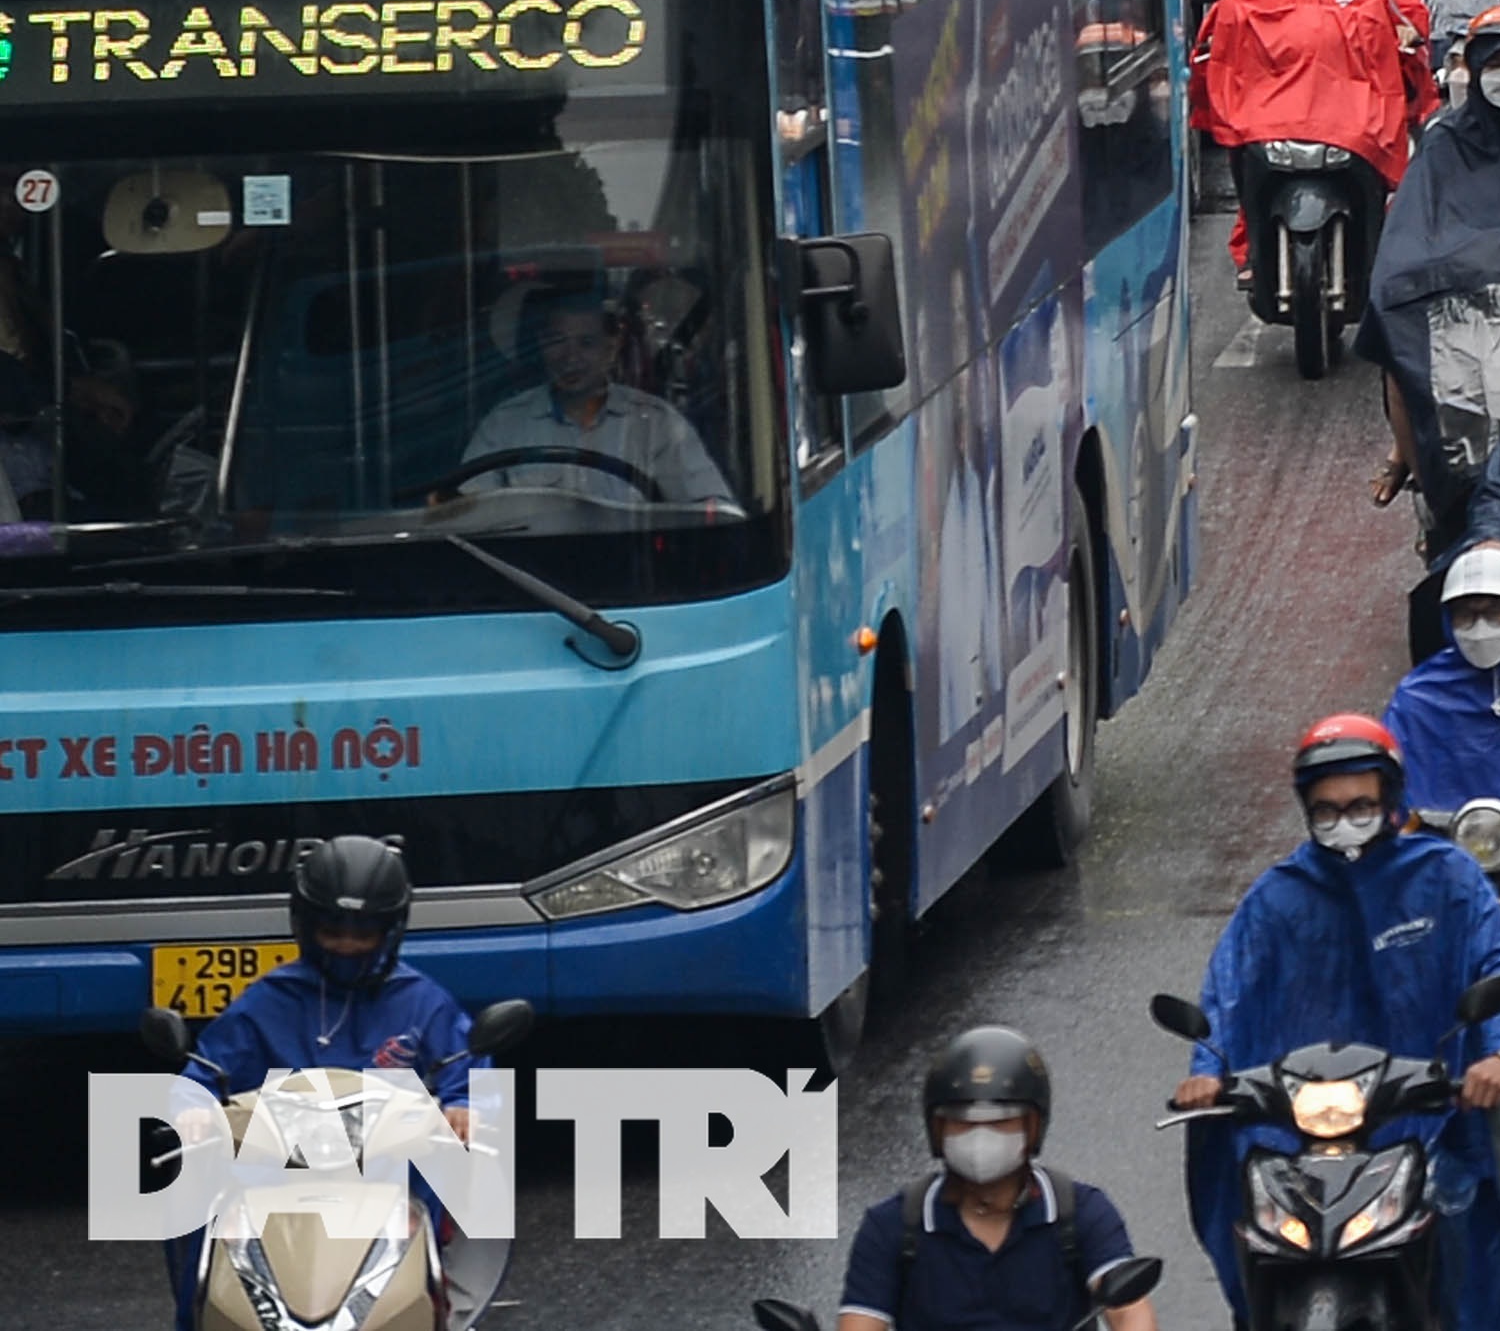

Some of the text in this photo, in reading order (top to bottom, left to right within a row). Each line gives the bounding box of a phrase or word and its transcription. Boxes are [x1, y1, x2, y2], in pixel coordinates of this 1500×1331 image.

[22, 179, 54, 204] 27
[59, 737, 117, 779] XE
[132, 724, 240, 788] ĐIỆN
[257, 723, 318, 774] HÀ
[333, 717, 421, 782] NỘI
[195, 948, 259, 980] 29B
